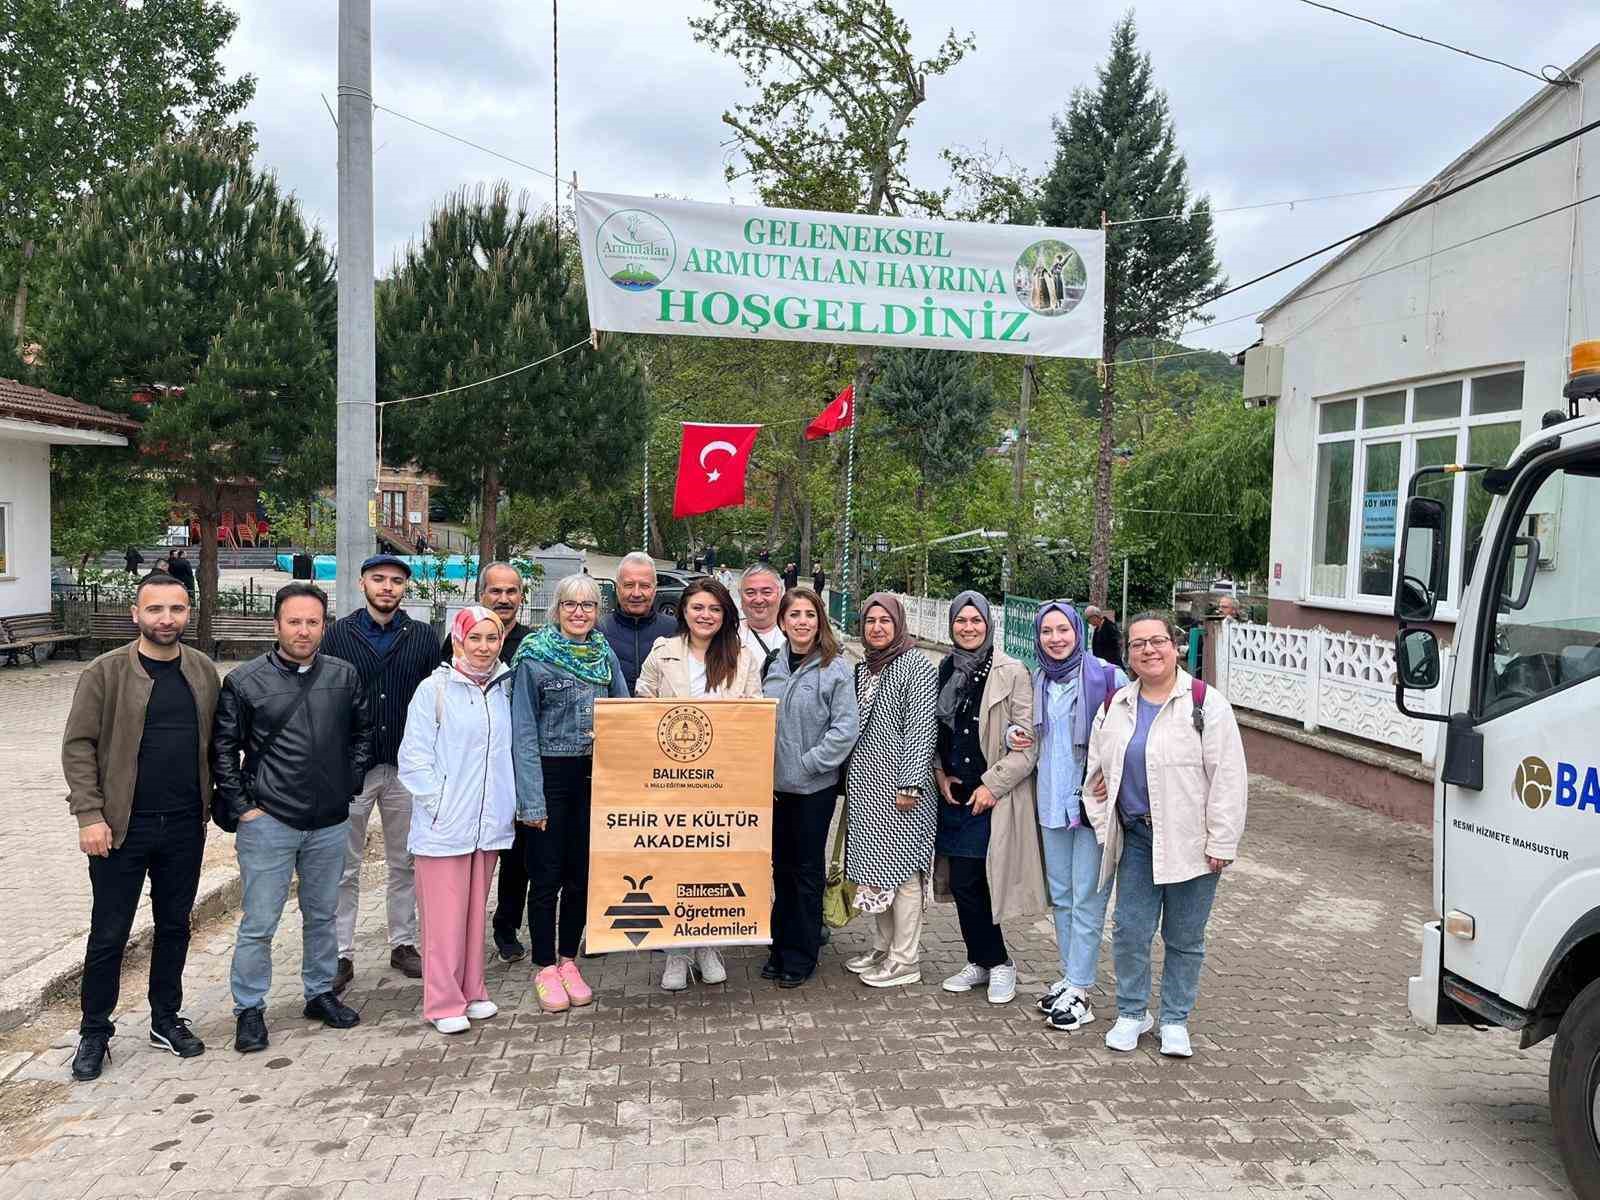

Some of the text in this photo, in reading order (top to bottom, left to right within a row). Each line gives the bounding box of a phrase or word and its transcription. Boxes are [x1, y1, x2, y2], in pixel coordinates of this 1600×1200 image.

[743, 217, 951, 258] GELENEKSEL
[682, 247, 1007, 294] ARMUTALAN HAYRINA
[655, 288, 1031, 343] HOŞGELDİNİZ
[652, 768, 715, 780] BALIKESİR
[606, 811, 759, 829] ŞEHİR VE KÜLTÜR
[634, 832, 731, 848] AKADEMİSİ
[1453, 818, 1569, 860] RESMİ HİZMETE MAHSUSTUR
[677, 885, 729, 897] Balıkesir
[674, 902, 746, 921] Öğretmen
[673, 922, 758, 937] Akademileri
